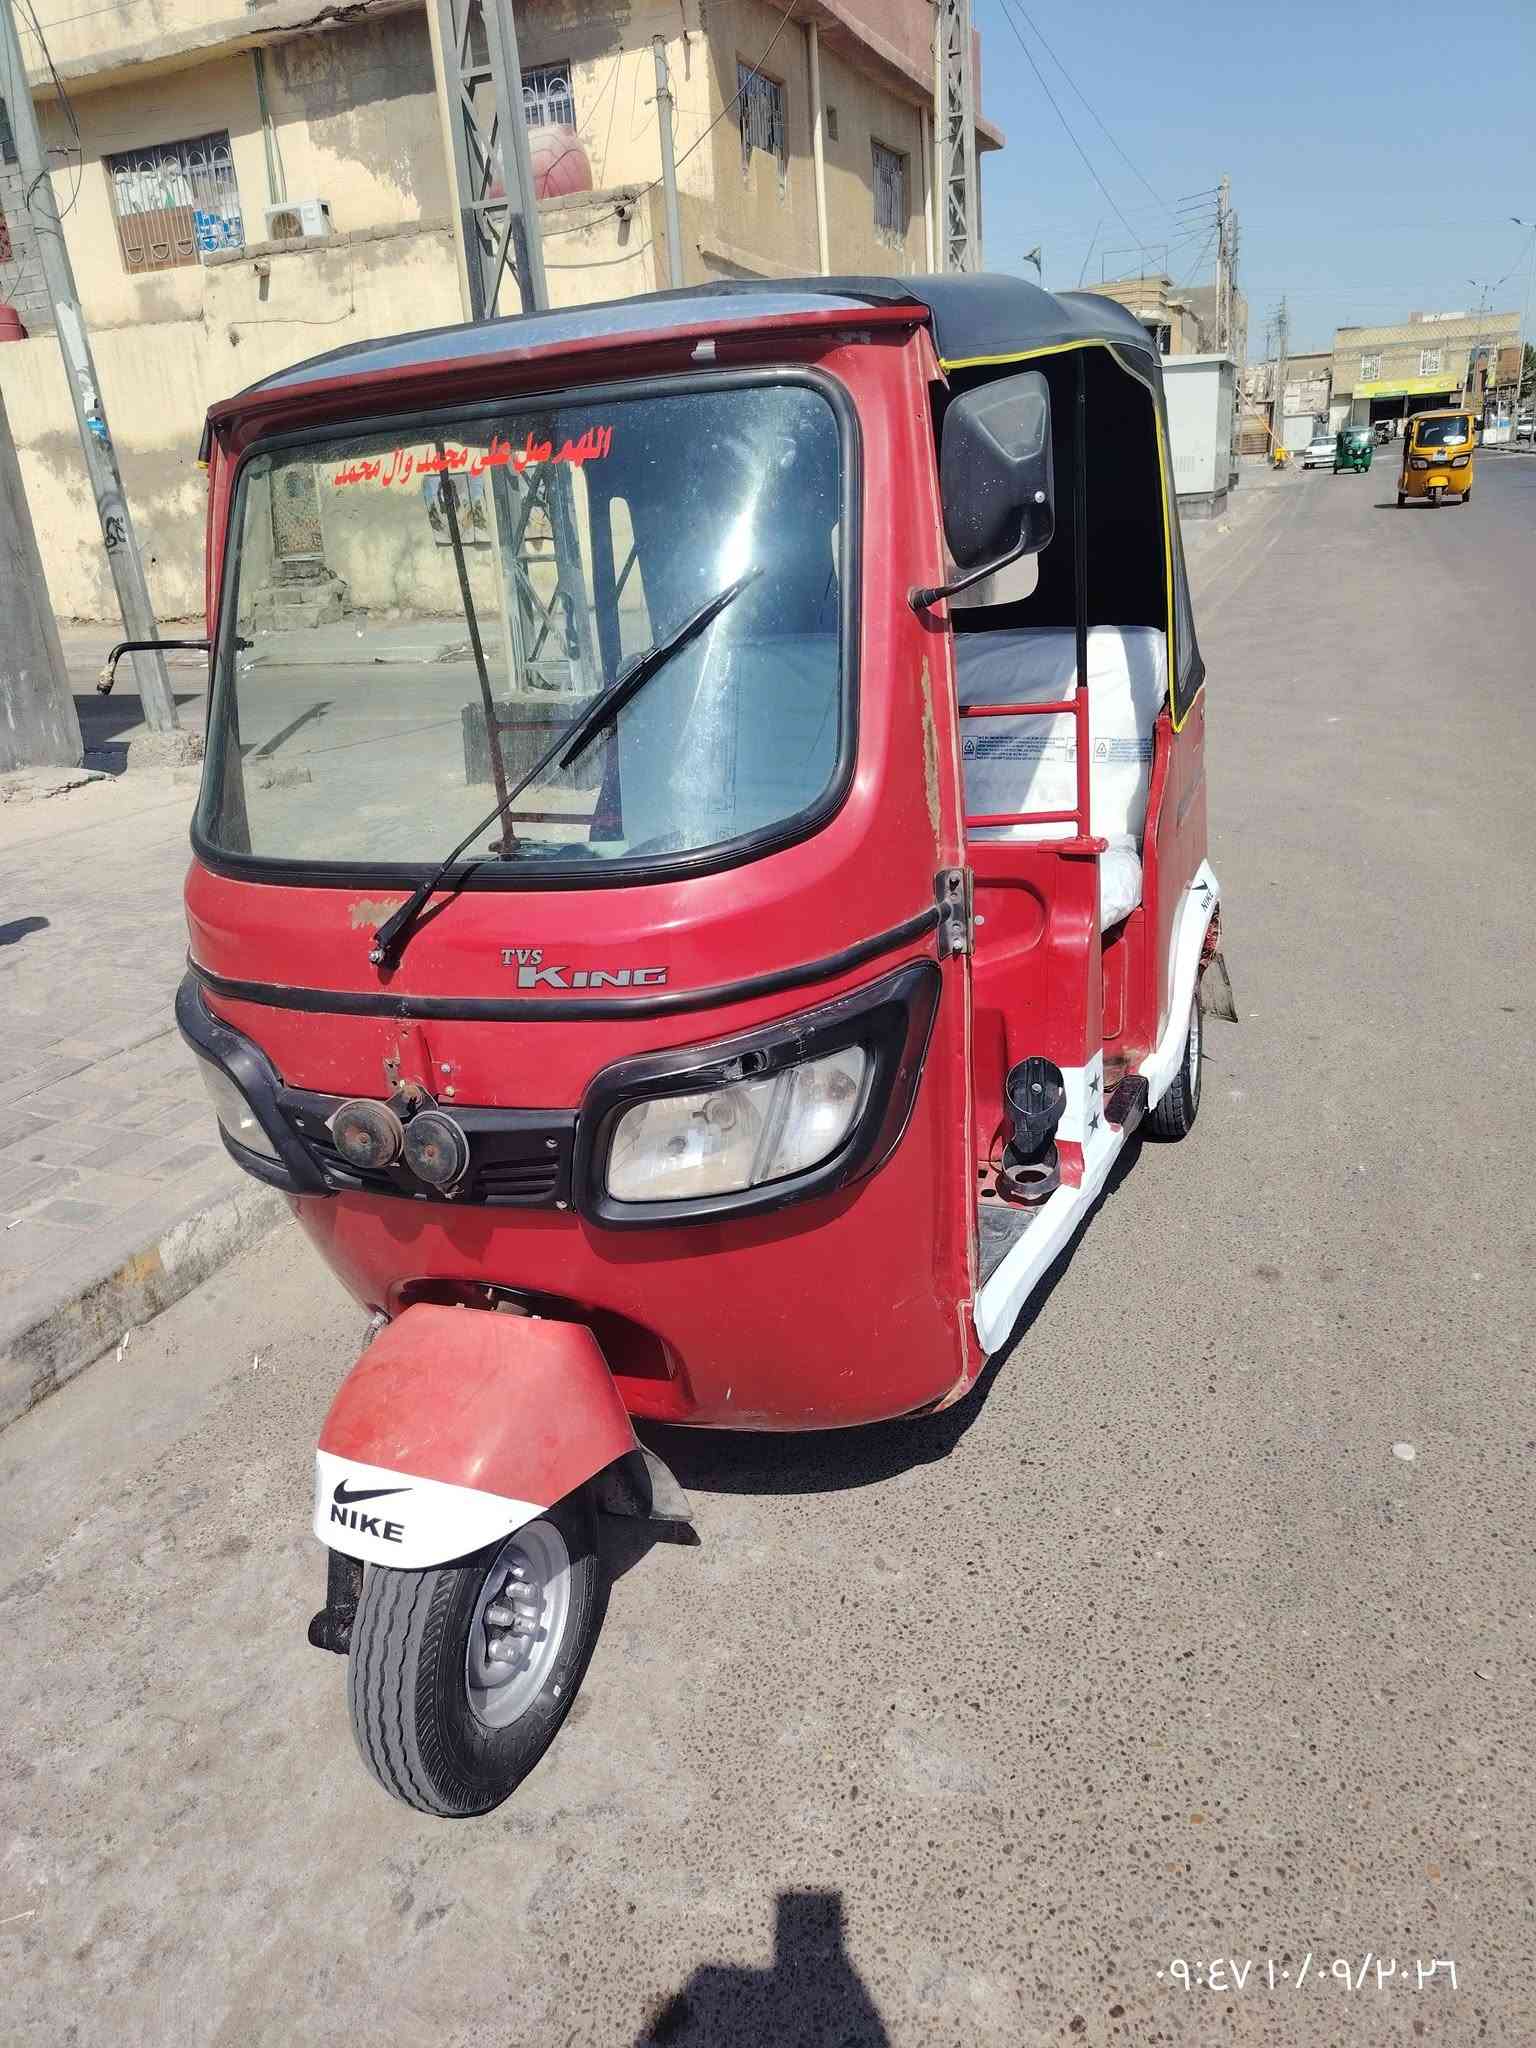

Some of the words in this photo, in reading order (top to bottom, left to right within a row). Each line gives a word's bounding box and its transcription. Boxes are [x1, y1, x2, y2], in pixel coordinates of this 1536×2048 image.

[470, 435, 513, 477] على
[515, 432, 553, 475] صل
[552, 424, 615, 467] اللهم
[334, 458, 381, 486] محمد
[416, 447, 469, 474] محمد
[1200, 888, 1214, 912] NIKE
[501, 948, 544, 967] TVS
[516, 966, 668, 989] KING
[330, 1503, 405, 1544] NIKE
